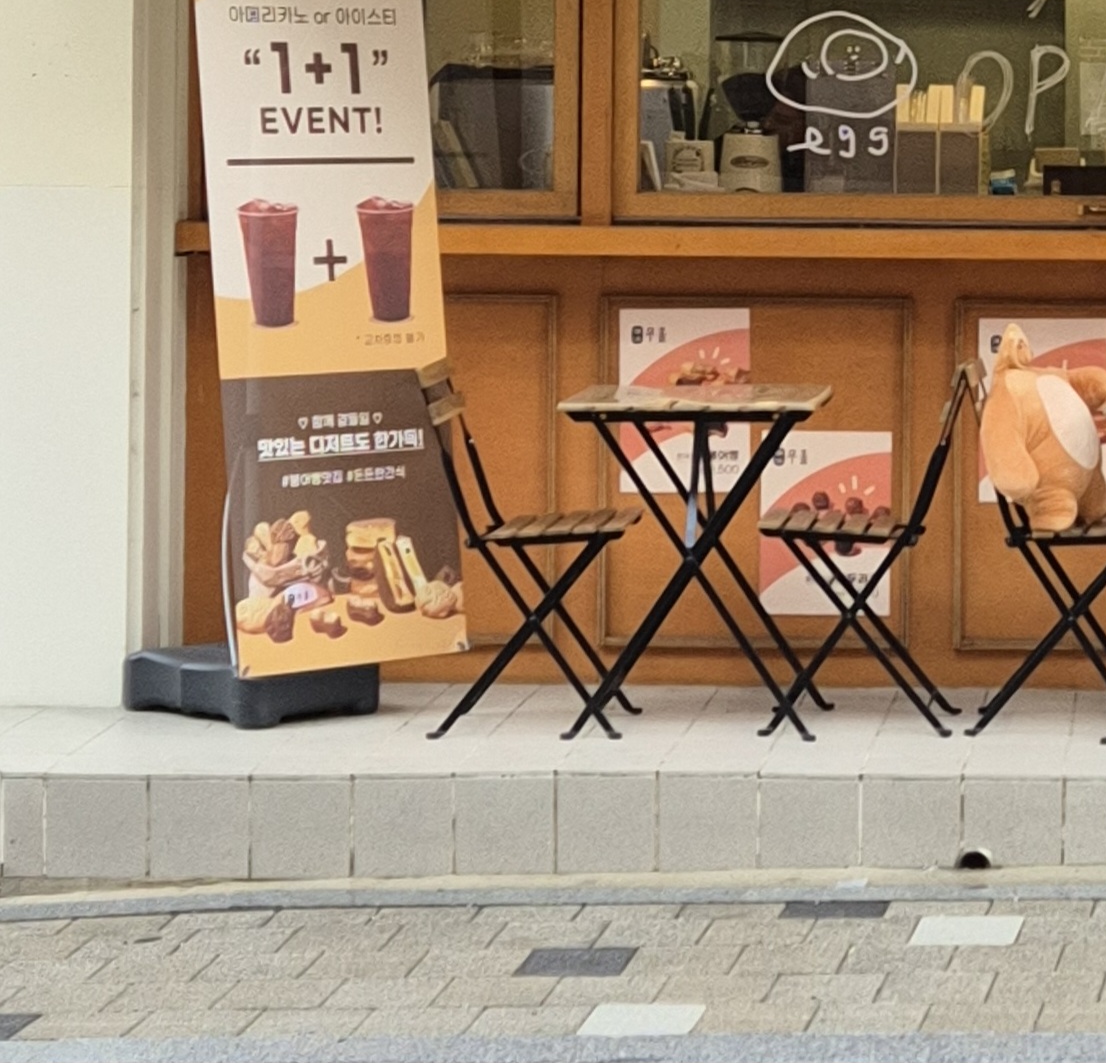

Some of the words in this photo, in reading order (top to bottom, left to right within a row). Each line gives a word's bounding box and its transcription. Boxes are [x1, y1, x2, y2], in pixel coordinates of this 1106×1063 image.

[229, 5, 309, 24] 아메리카노
[313, 10, 331, 24] or
[335, 7, 397, 26] 아이스티
[260, 106, 382, 134] EVENT!
[786, 125, 890, 158] egg
[257, 437, 306, 459] 맛있는
[308, 432, 371, 455] 디저트도
